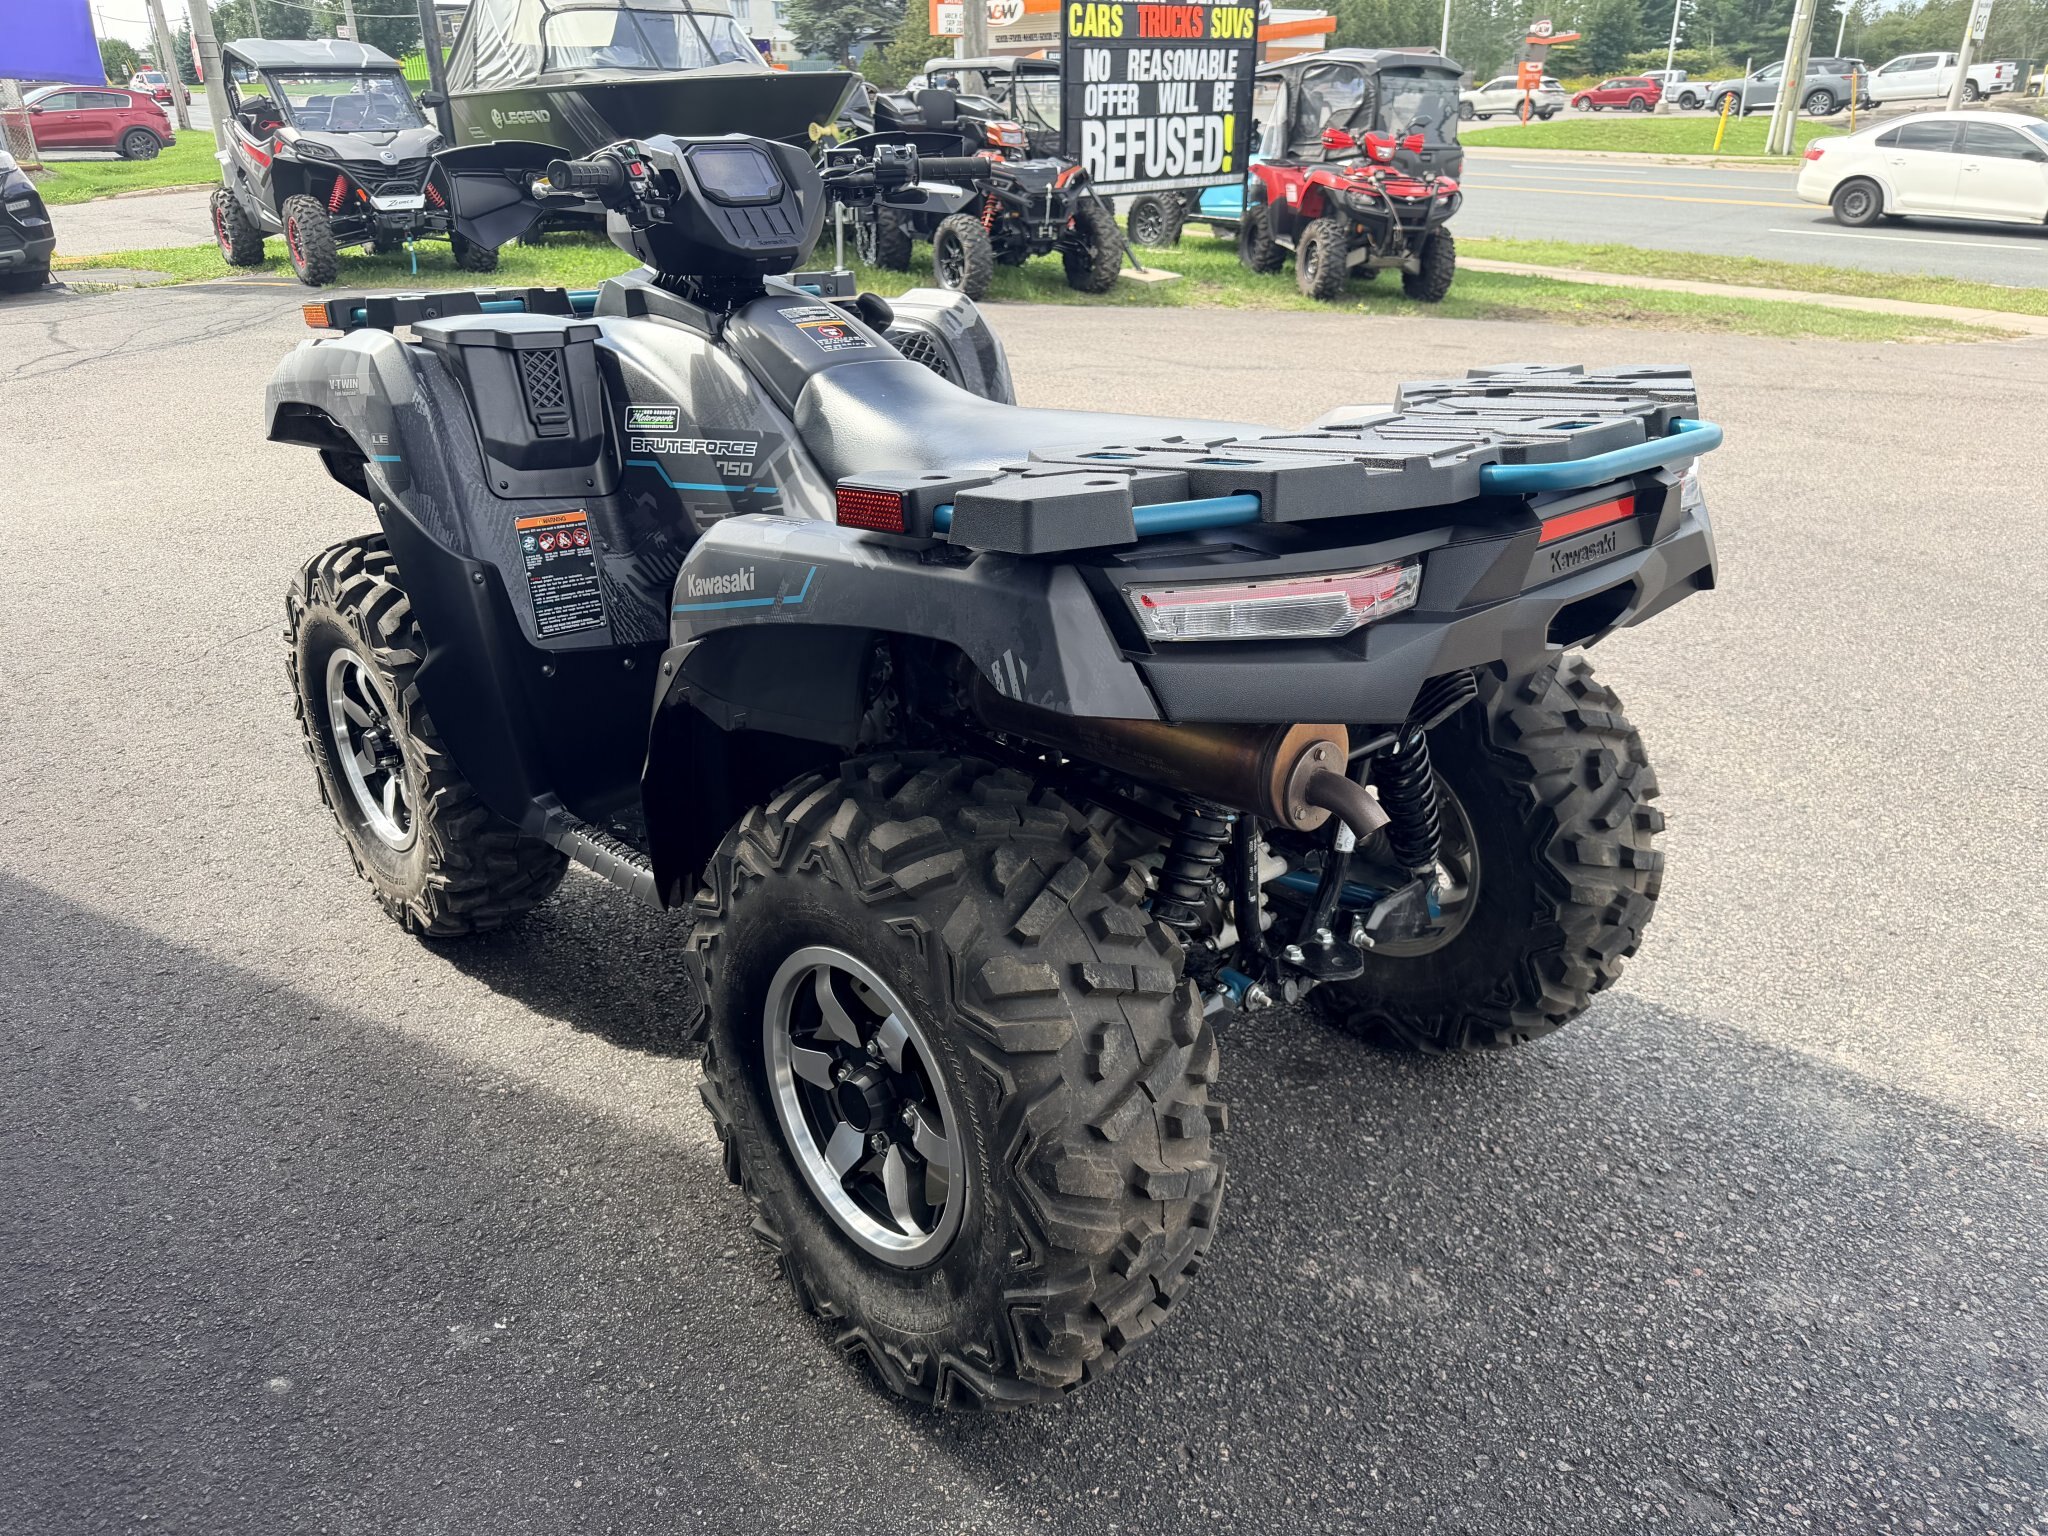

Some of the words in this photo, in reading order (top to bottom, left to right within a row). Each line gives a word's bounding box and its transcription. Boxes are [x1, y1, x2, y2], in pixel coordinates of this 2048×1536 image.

[1068, 3, 1124, 38] CARS
[1137, 4, 1204, 38] TRUCKS
[1210, 7, 1255, 39] SUVS
[1975, 15, 1987, 32] 60
[1083, 49, 1111, 82] NO
[1127, 49, 1239, 81] REASONABLE
[1084, 83, 1140, 116] OFFER
[1158, 82, 1198, 114] WILL
[1212, 81, 1235, 112] BE
[501, 110, 551, 125] LEGEND
[1081, 113, 1236, 183] REFUSED!
[329, 378, 359, 390] V-TWIN
[371, 433, 389, 445] LE
[631, 437, 693, 454] BRUTE
[693, 439, 758, 457] FORCE
[716, 460, 753, 477] 750
[1550, 530, 1616, 574] Kawasaki
[687, 566, 755, 598] Kawasaki
